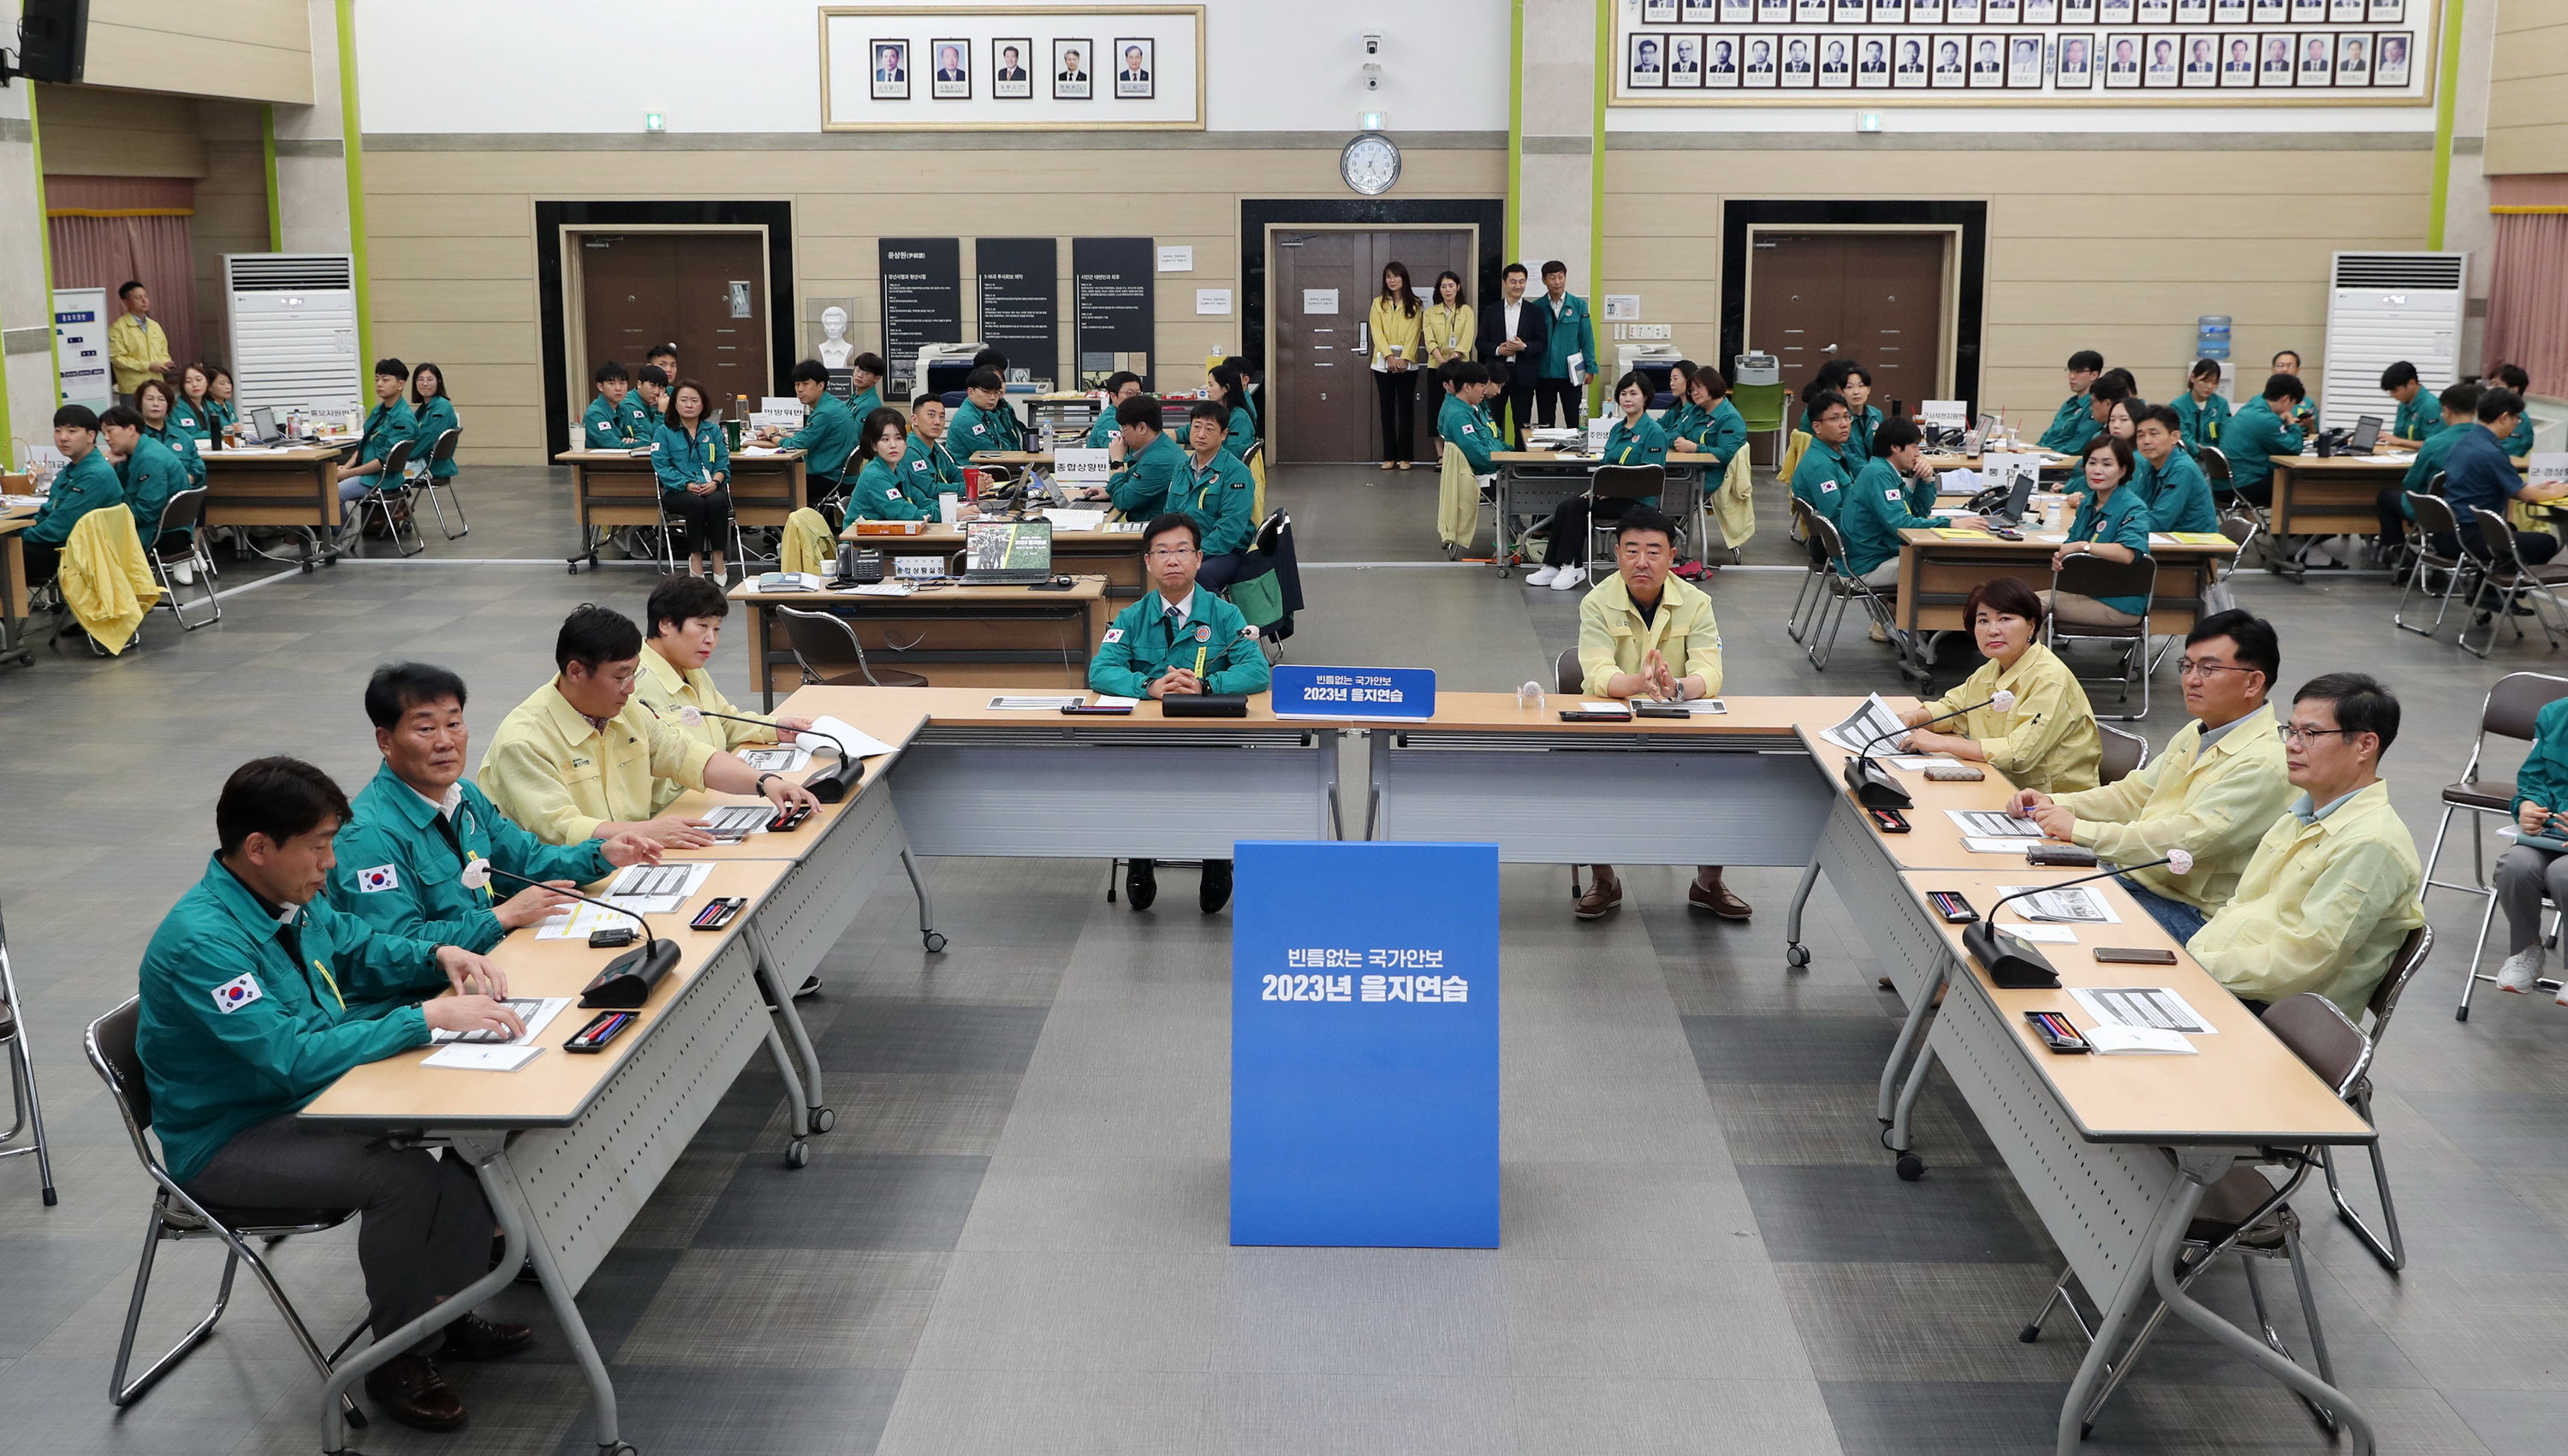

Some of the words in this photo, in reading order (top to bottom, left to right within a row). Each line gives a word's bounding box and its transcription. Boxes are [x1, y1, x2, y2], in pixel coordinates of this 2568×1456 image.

[1056, 463, 1107, 472] 종합상황반
[1316, 675, 1352, 685] 빈틈없는
[1355, 676, 1392, 686] 국가안보
[1304, 686, 1347, 701] 2023년
[1351, 687, 1404, 703] 을지연습
[1288, 948, 1363, 968] 빈틈없는
[1368, 949, 1444, 969] 국가안보
[1262, 974, 1352, 1001] 2023년
[1360, 975, 1469, 1003] 을지연습
